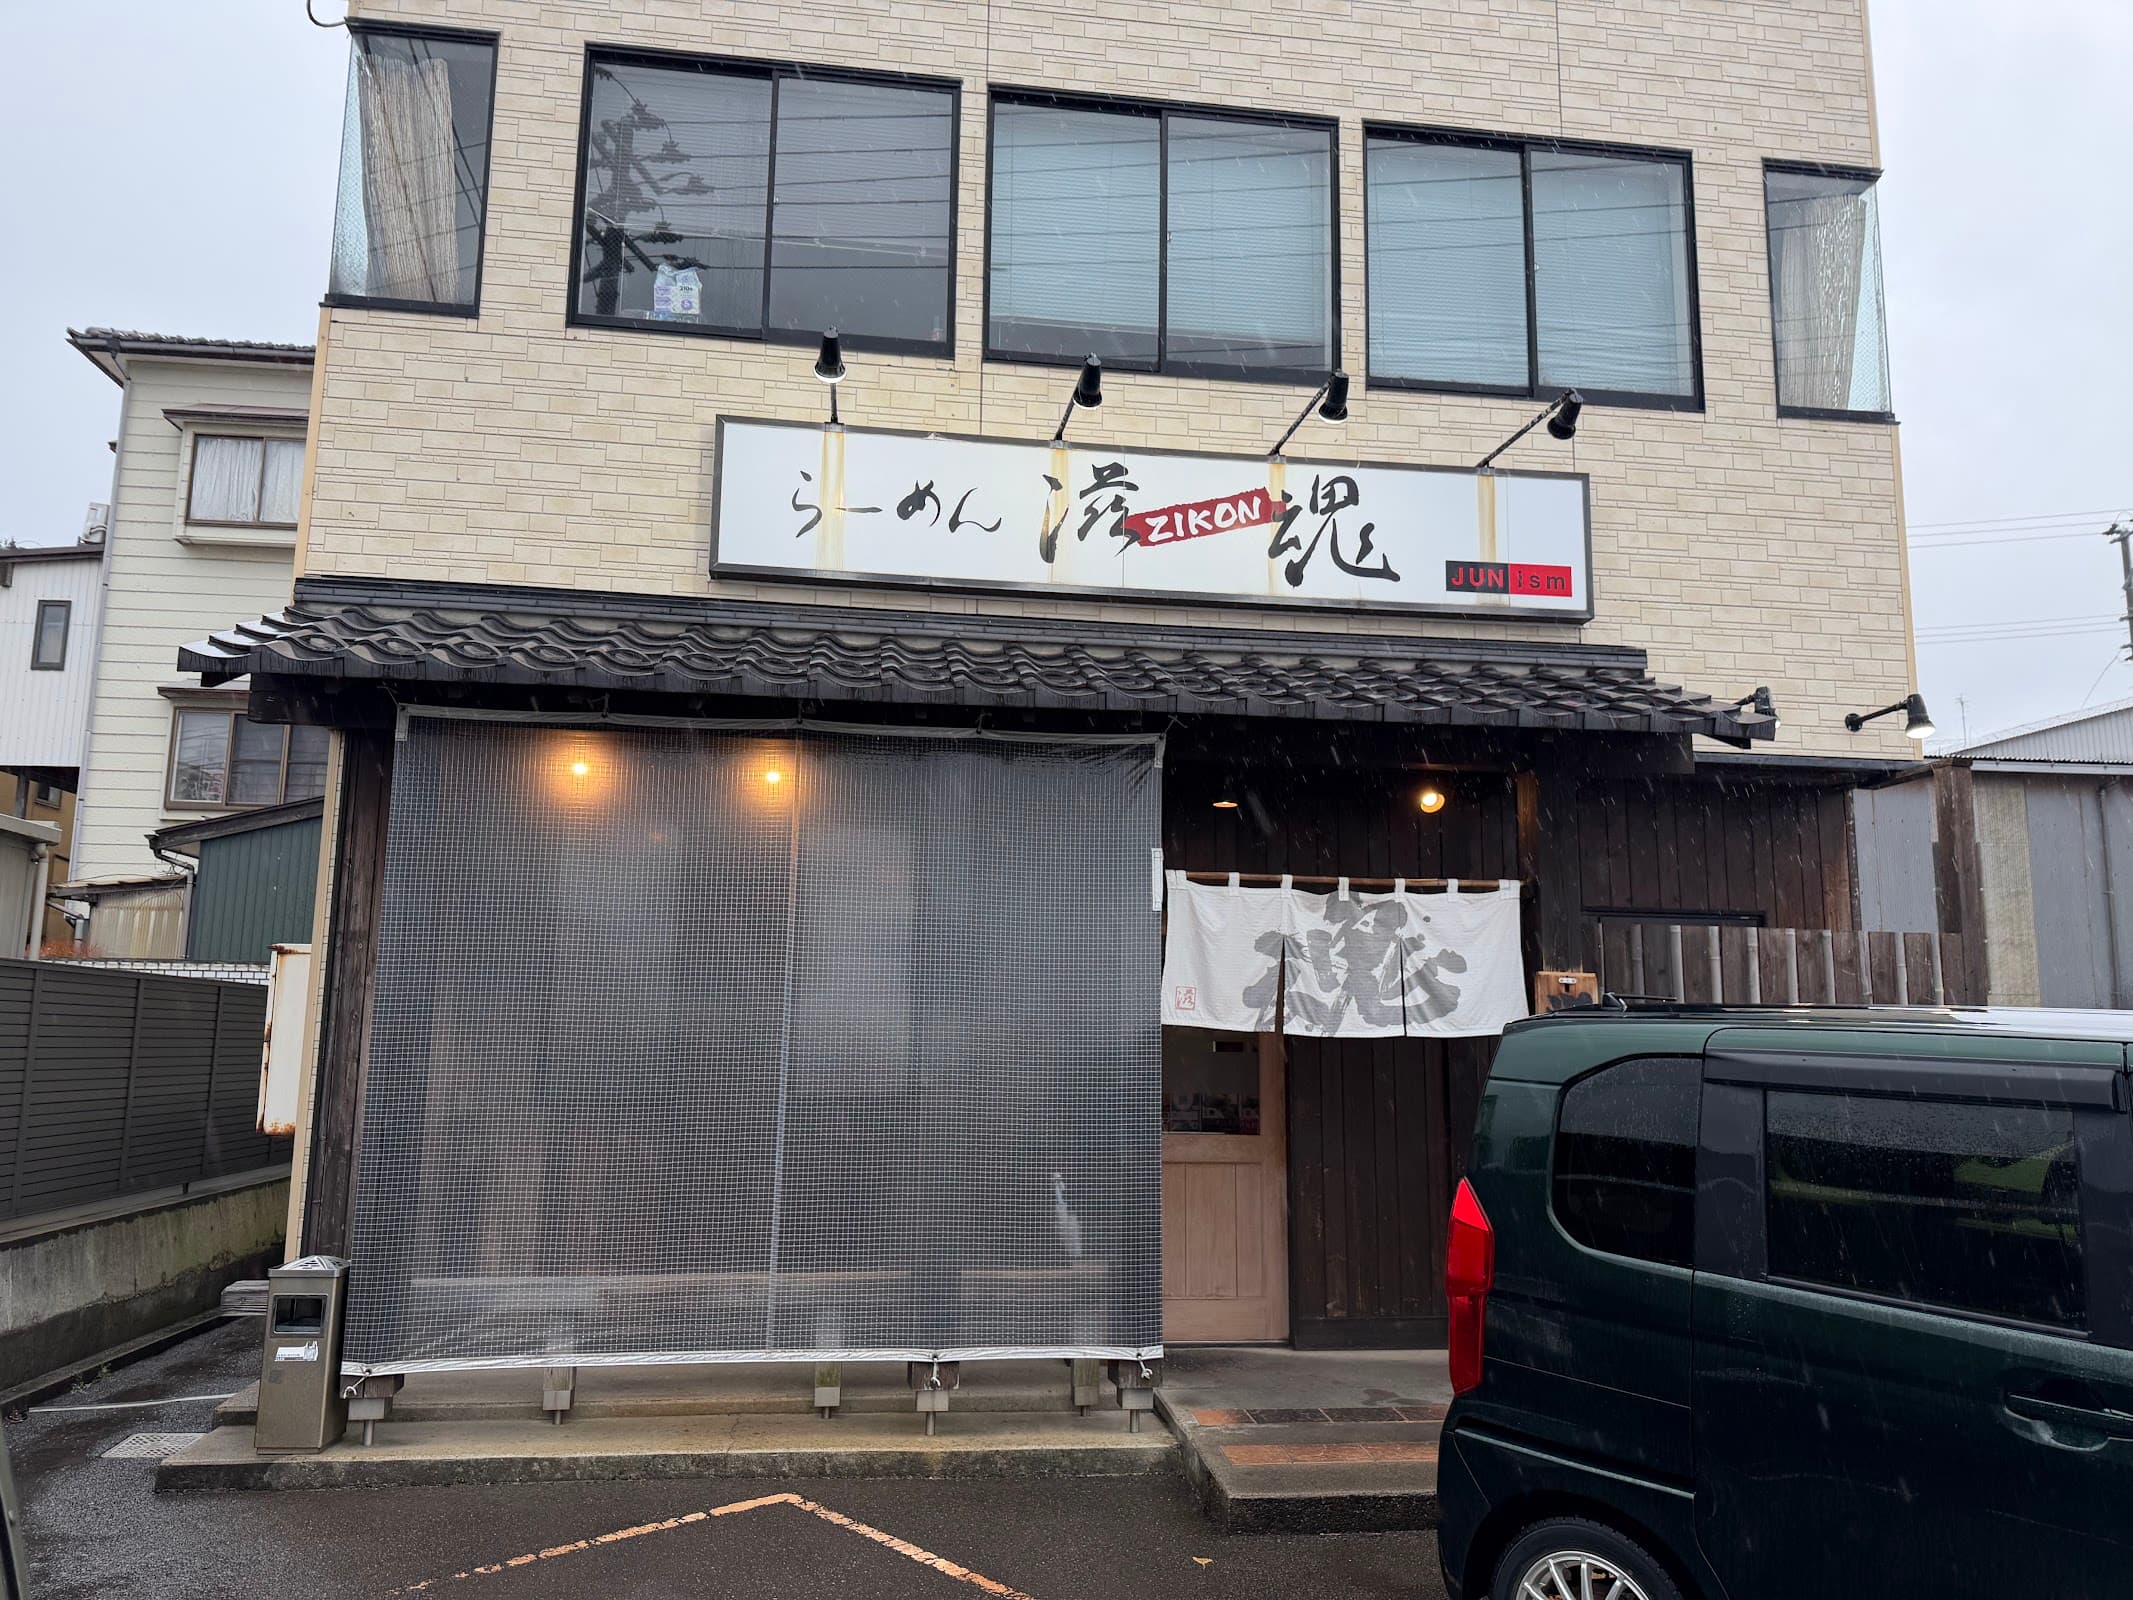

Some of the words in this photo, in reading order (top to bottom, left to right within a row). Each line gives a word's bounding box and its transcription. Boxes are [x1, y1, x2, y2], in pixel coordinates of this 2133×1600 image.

[792, 470, 1002, 538] らーめん
[1145, 497, 1262, 543] ZIKON
[1451, 567, 1504, 588] JUN
[1518, 571, 1566, 590] ism
